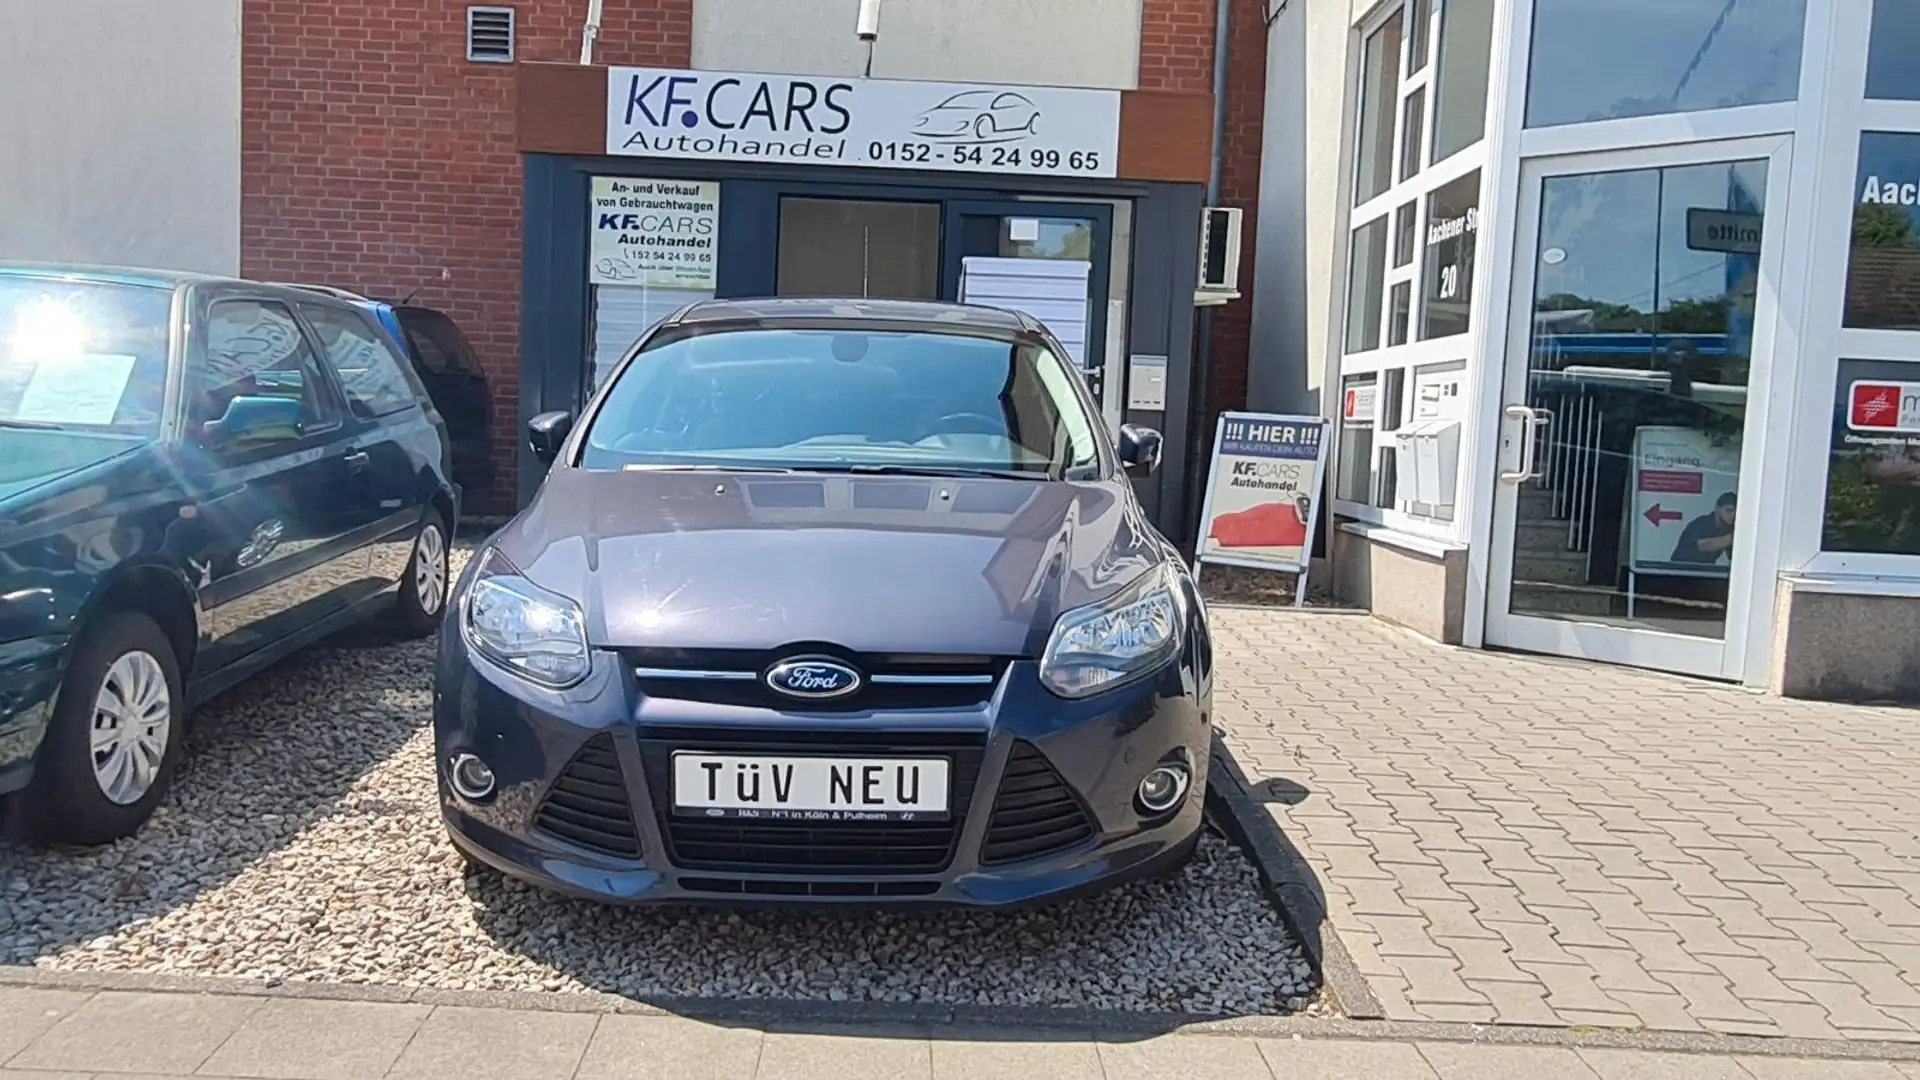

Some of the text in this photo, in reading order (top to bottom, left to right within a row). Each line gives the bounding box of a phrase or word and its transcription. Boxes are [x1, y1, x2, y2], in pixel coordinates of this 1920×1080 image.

[624, 74, 853, 135] KF.CARS
[622, 131, 846, 159] Autohandel
[868, 142, 931, 162] 0152
[953, 146, 982, 165] 54
[991, 148, 1021, 166] 24
[1030, 149, 1060, 168] 99
[1069, 151, 1099, 170] 65
[612, 182, 700, 196] An- und Verkauf
[597, 197, 713, 213] von Gebrauchtwagen
[598, 213, 713, 235] KF.CARS
[1426, 215, 1465, 246] Aachener
[618, 234, 711, 248] Autohandel
[653, 251, 665, 260] 54
[668, 252, 680, 261] 24
[699, 254, 711, 262] 65
[1440, 264, 1457, 299] 20
[1226, 422, 1320, 445] !!! HIER !!!
[1232, 460, 1300, 480] KF.CARS
[1231, 477, 1298, 492] Autohandel
[788, 667, 838, 689] Ford
[830, 765, 919, 804] NEU
[805, 810, 829, 819] Köln
